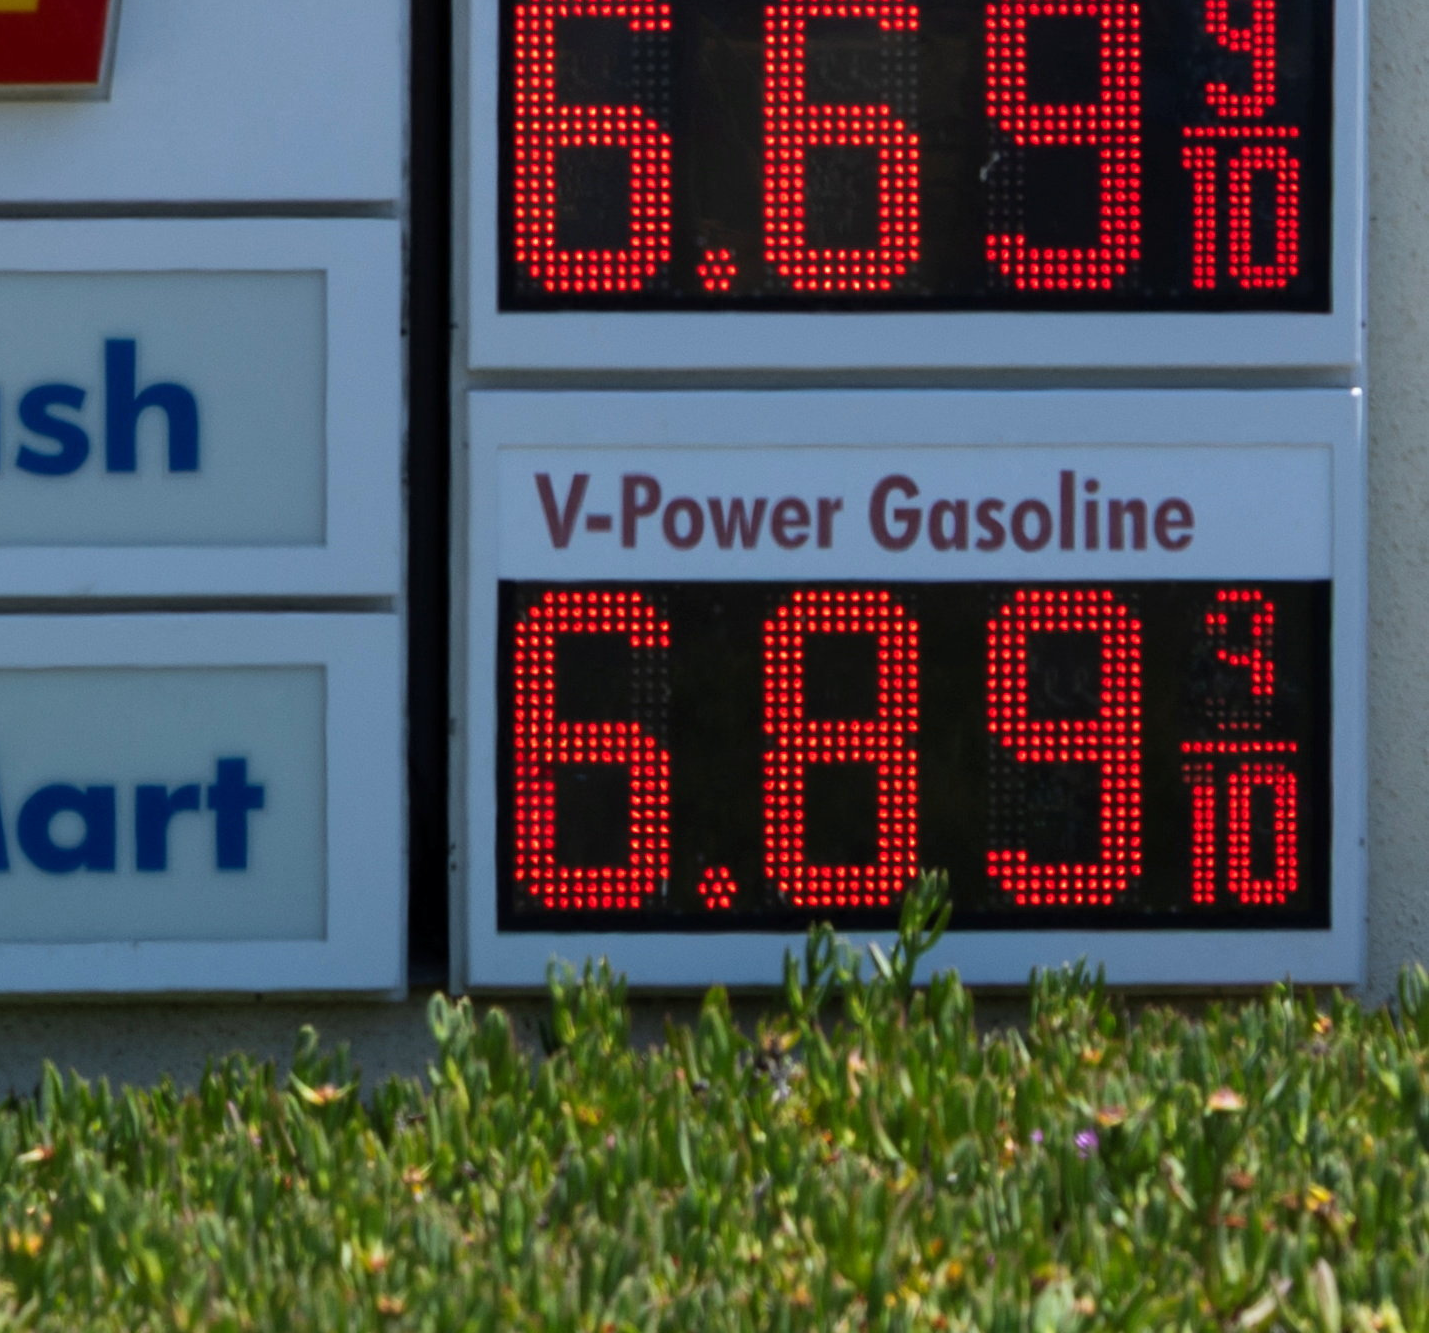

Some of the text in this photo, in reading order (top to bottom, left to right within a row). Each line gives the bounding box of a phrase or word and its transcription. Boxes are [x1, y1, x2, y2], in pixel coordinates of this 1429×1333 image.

[534, 469, 1196, 553] V-Power Gasoline
[512, 588, 1144, 911] 6.89
